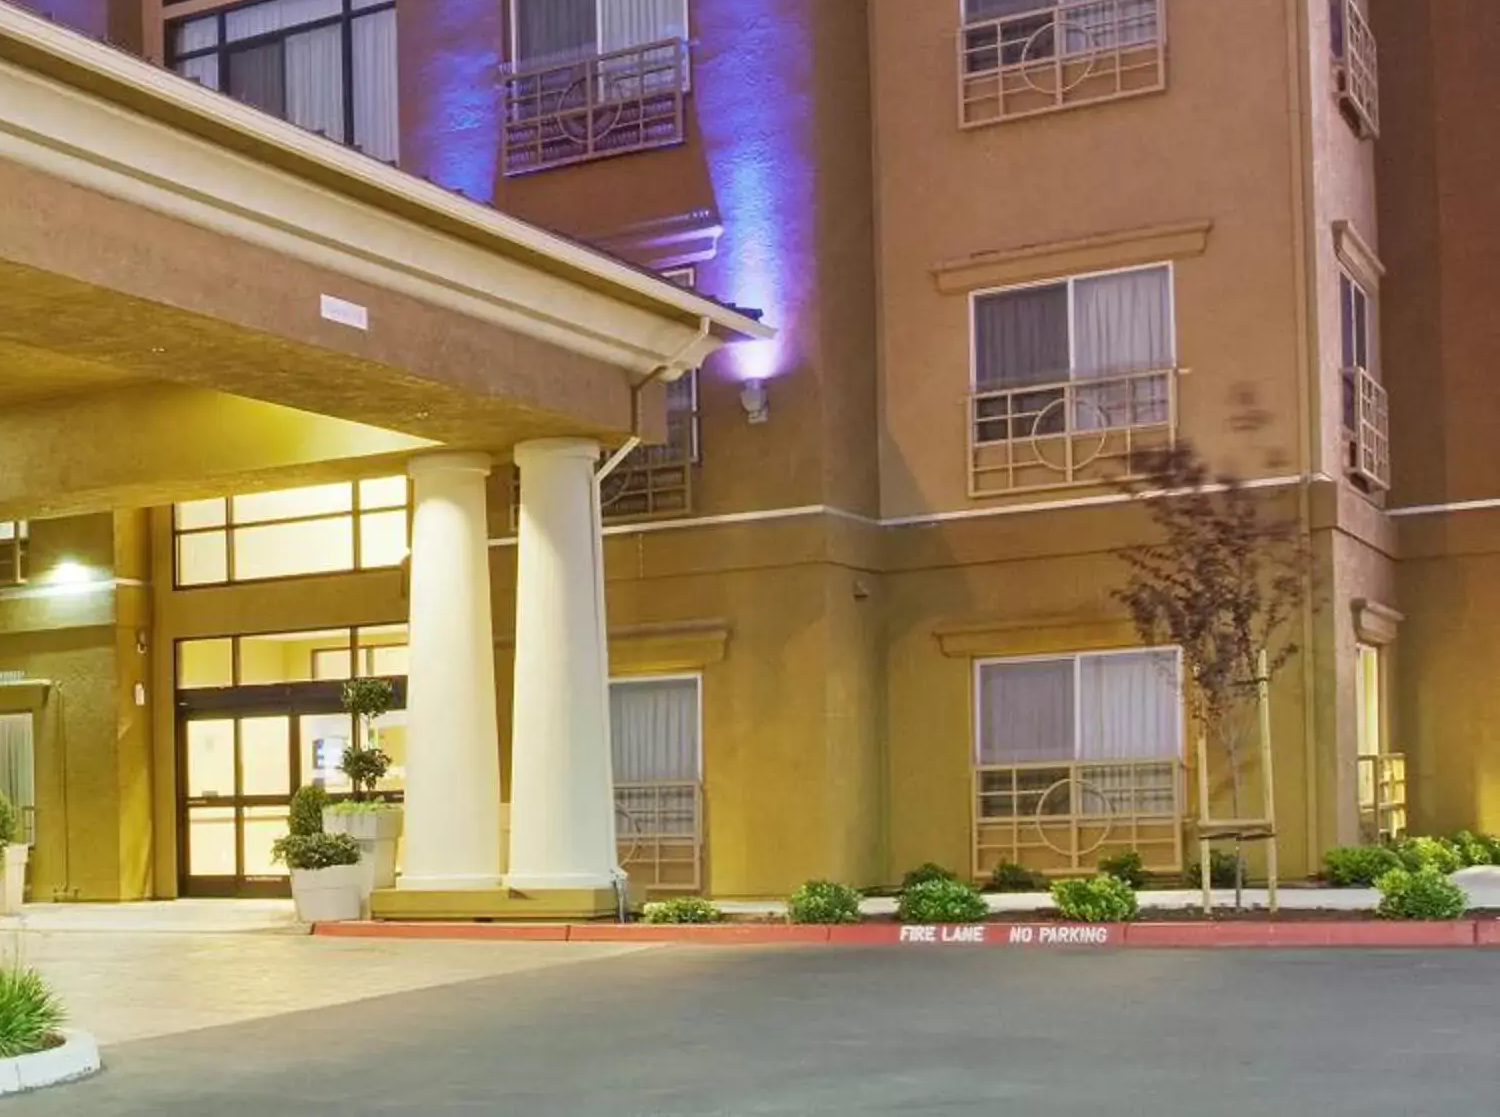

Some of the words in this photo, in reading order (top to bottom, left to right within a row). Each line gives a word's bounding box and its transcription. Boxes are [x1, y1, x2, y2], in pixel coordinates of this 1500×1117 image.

[900, 925, 935, 942] FIRE
[941, 926, 985, 942] LANE
[1009, 926, 1033, 943] NO
[1039, 926, 1107, 943] PARKING
